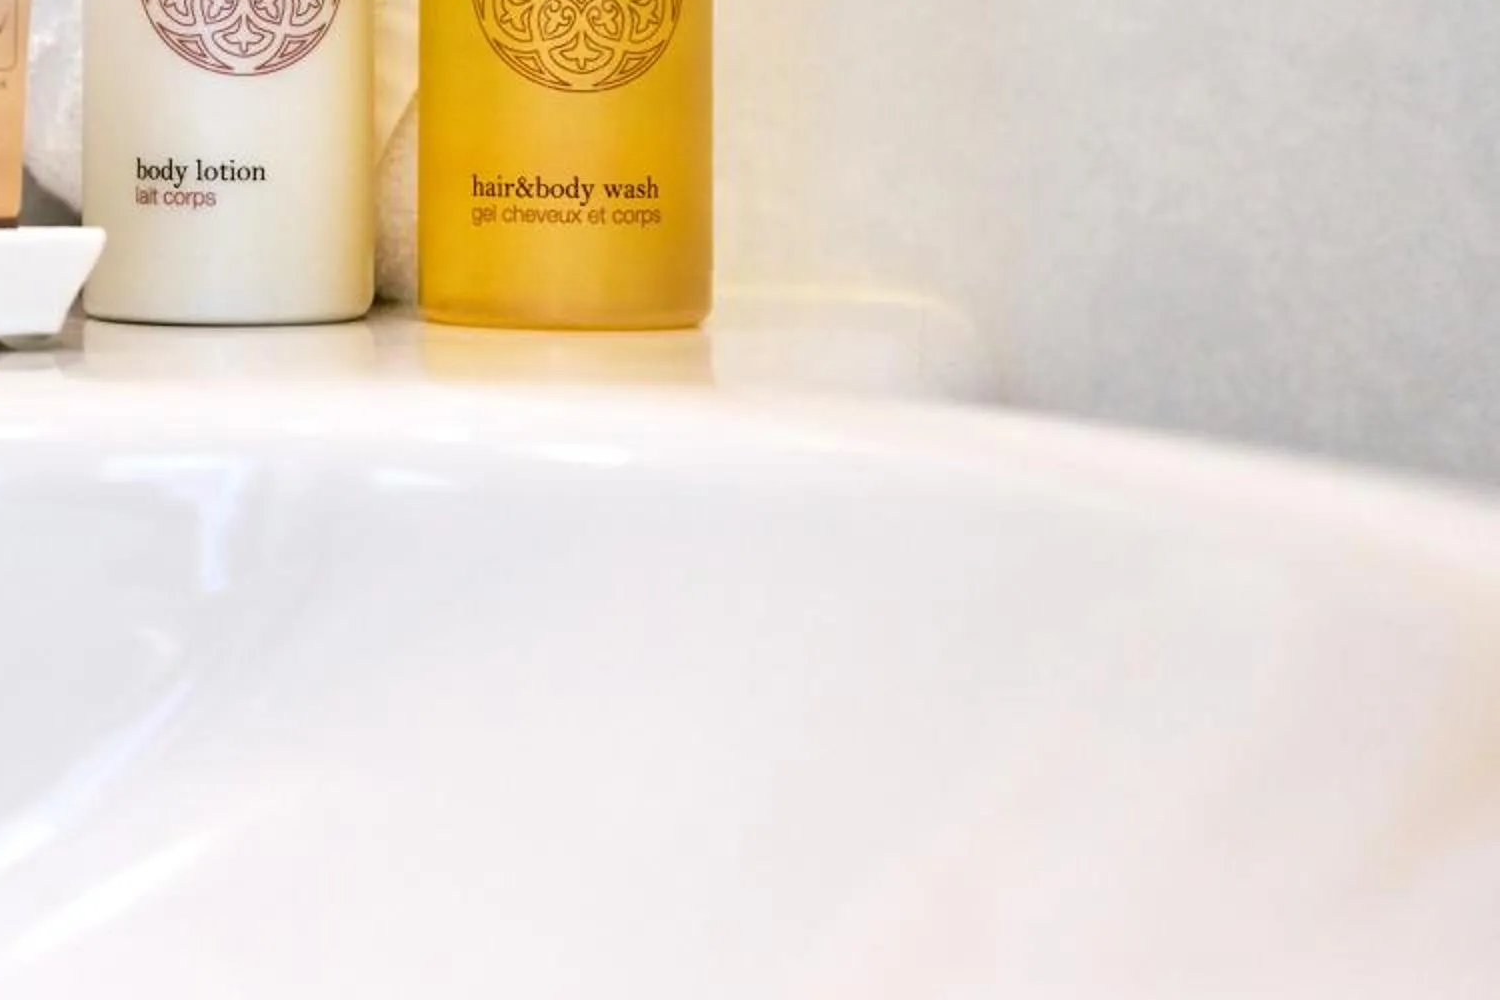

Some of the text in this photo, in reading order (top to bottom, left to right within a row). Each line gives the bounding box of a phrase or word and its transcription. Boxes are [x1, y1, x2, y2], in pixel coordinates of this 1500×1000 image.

[136, 157, 266, 189] body lotion
[135, 186, 217, 209] lait corps
[471, 173, 660, 207] hair&body wash
[471, 204, 662, 228] gel cheveux et corps
